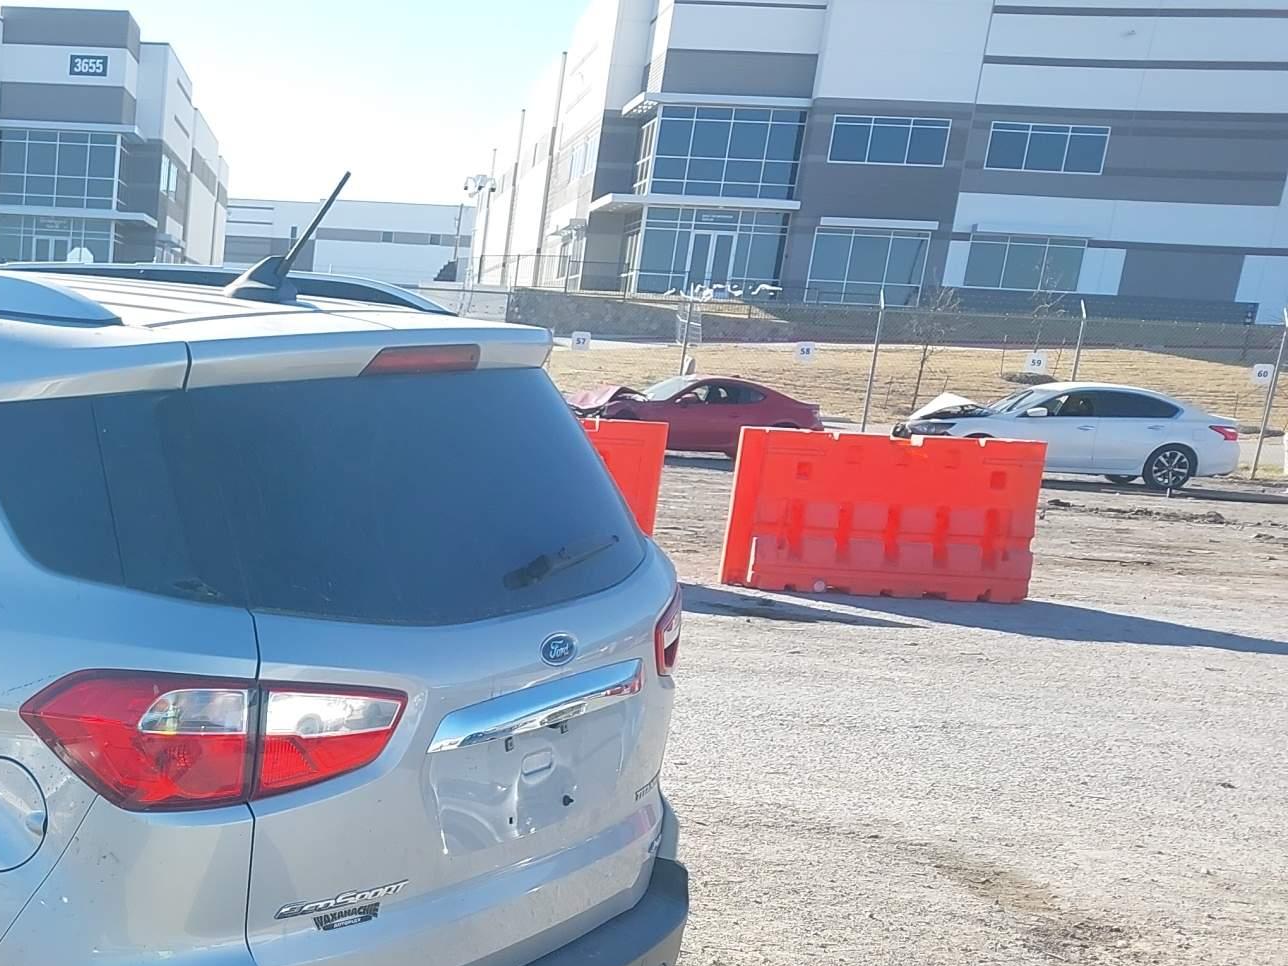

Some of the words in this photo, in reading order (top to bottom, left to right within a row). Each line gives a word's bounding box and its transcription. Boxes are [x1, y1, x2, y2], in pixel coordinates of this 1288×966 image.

[73, 58, 104, 73] 3655
[575, 337, 587, 346] 57
[799, 347, 811, 356] 58
[1031, 358, 1042, 368] 59
[1257, 369, 1269, 379] 60
